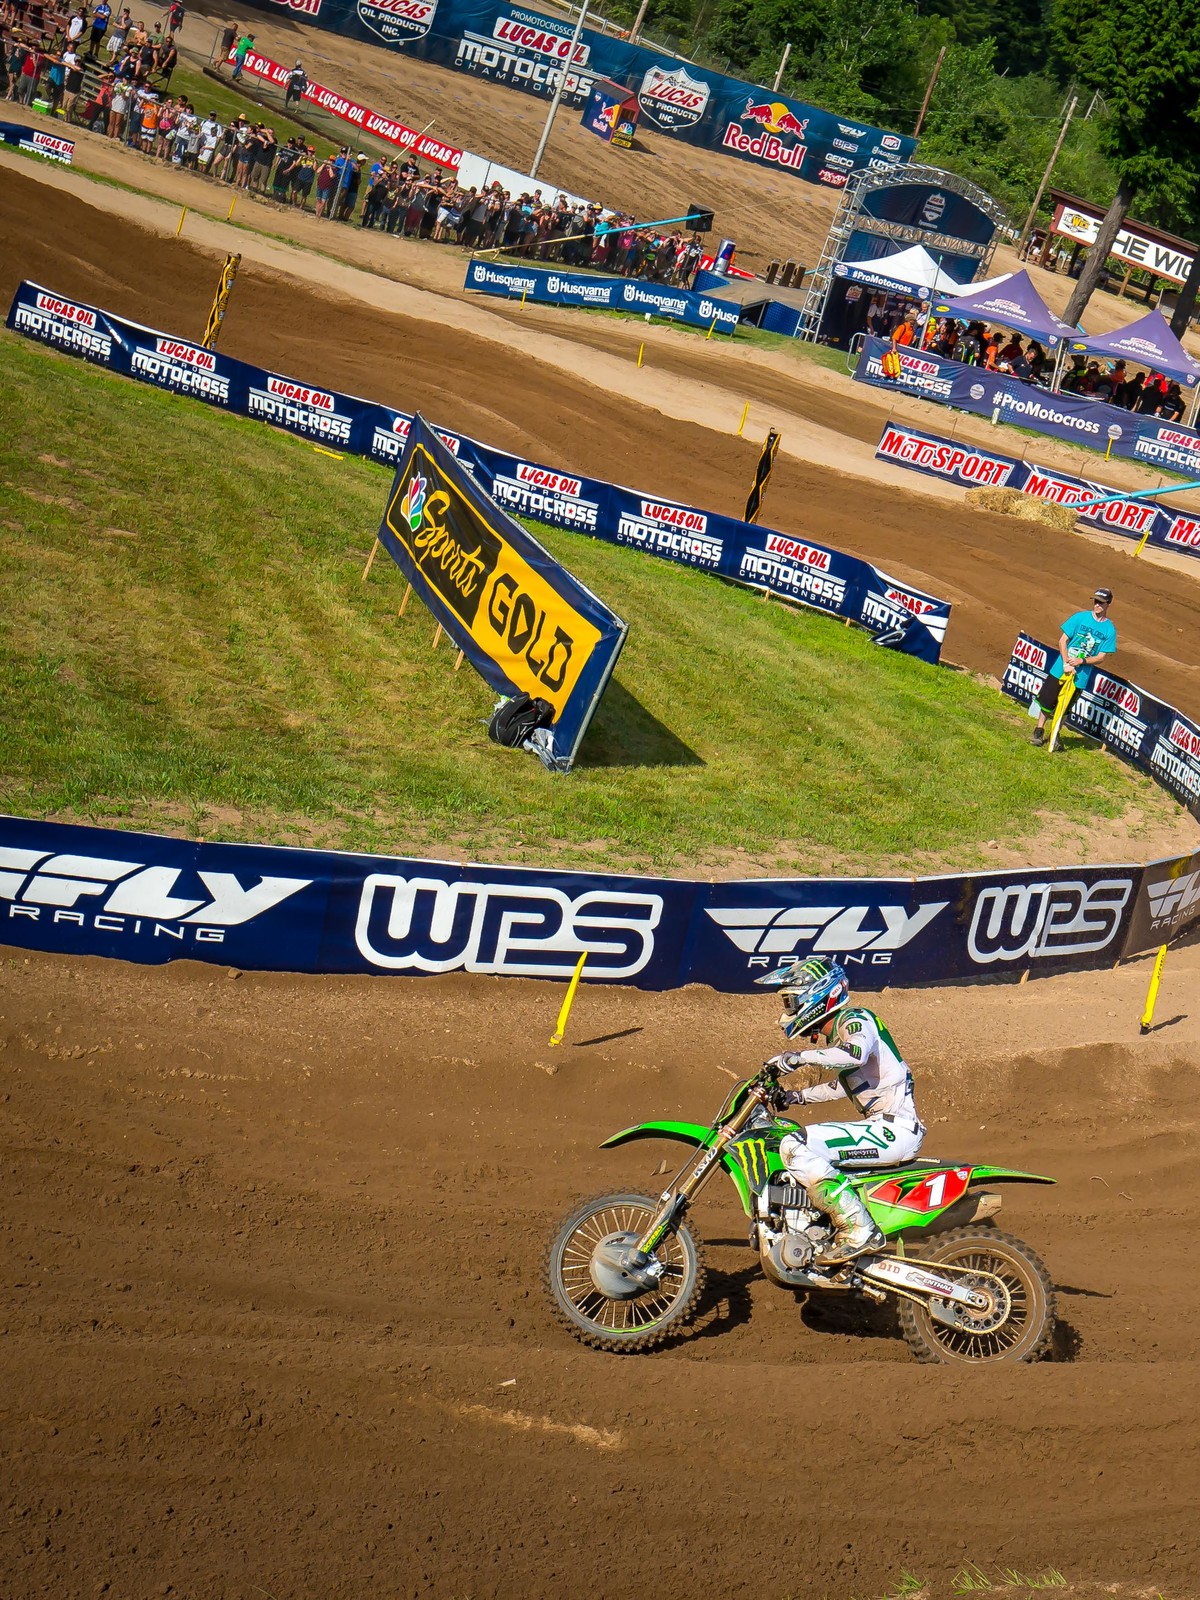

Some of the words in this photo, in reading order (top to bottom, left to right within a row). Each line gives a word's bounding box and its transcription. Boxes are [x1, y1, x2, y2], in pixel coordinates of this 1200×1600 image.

[360, 7, 376, 18] OIL
[377, 12, 426, 34] PRODUCTS
[381, 24, 400, 37] INC.
[497, 21, 557, 54] LUCAS
[254, 59, 270, 75] OIL
[317, 90, 348, 115] LUCAS
[348, 106, 364, 124] OIL
[366, 115, 399, 139] LUCAS
[399, 130, 416, 148] OIL
[418, 138, 450, 163] LUCAS
[641, 97, 654, 107] OIL
[656, 102, 698, 121] PRODUCTS
[648, 83, 704, 108] LUCAS
[659, 113, 674, 123] INC.
[35, 134, 61, 150] LUCAS
[61, 142, 75, 154] OIL
[825, 153, 854, 168] GEICO
[486, 270, 536, 289] Husqvarna
[560, 281, 611, 297] Husqvarna
[852, 270, 912, 294] #ProMotocross
[39, 296, 76, 319] LUCAS
[76, 310, 94, 327] OIL
[635, 291, 687, 309] Husqvarna
[14, 322, 110, 362] CHAMPIONSHIP
[15, 308, 112, 357] MOTOCROSS
[158, 340, 195, 363] LUCAS
[196, 353, 214, 370] OIL
[922, 361, 937, 374] OIL
[130, 365, 229, 405] CHAMPIONSHIP
[131, 352, 230, 398] MOTOCROSS
[271, 380, 309, 402] LUCAS
[311, 393, 332, 409] OIL
[248, 393, 351, 439] MOTOCROSS
[248, 407, 350, 445] CHAMPIONSHIP
[992, 391, 1101, 434] #ProMotocross
[1160, 430, 1193, 448] LUCAS
[520, 466, 559, 489] LUCAS
[560, 477, 579, 496] OIL
[492, 479, 598, 526] MOTOCROSS
[645, 503, 682, 525] LUCAS
[680, 511, 704, 531] OIL
[415, 490, 487, 598] Sports
[617, 532, 719, 568] CHAMPIONSHIP
[618, 518, 723, 562] MOTOCROSS
[768, 536, 808, 560] LUCAS
[809, 550, 828, 569] OIL
[741, 553, 846, 602] MOTOCROSS
[488, 572, 574, 693] GOLD
[1030, 648, 1045, 668] OIL
[1096, 677, 1126, 705] LUCAS
[1125, 692, 1139, 714] OIL
[1072, 697, 1145, 750] MOTOCROSS
[1169, 722, 1191, 752] LUCAS
[0, 846, 314, 926] FLY
[9, 904, 226, 943] RACING
[355, 873, 664, 978] WPS
[704, 901, 950, 953] FLY
[967, 879, 1133, 964] WPS
[1150, 904, 1196, 931] RACING
[925, 1173, 947, 1209] 1
